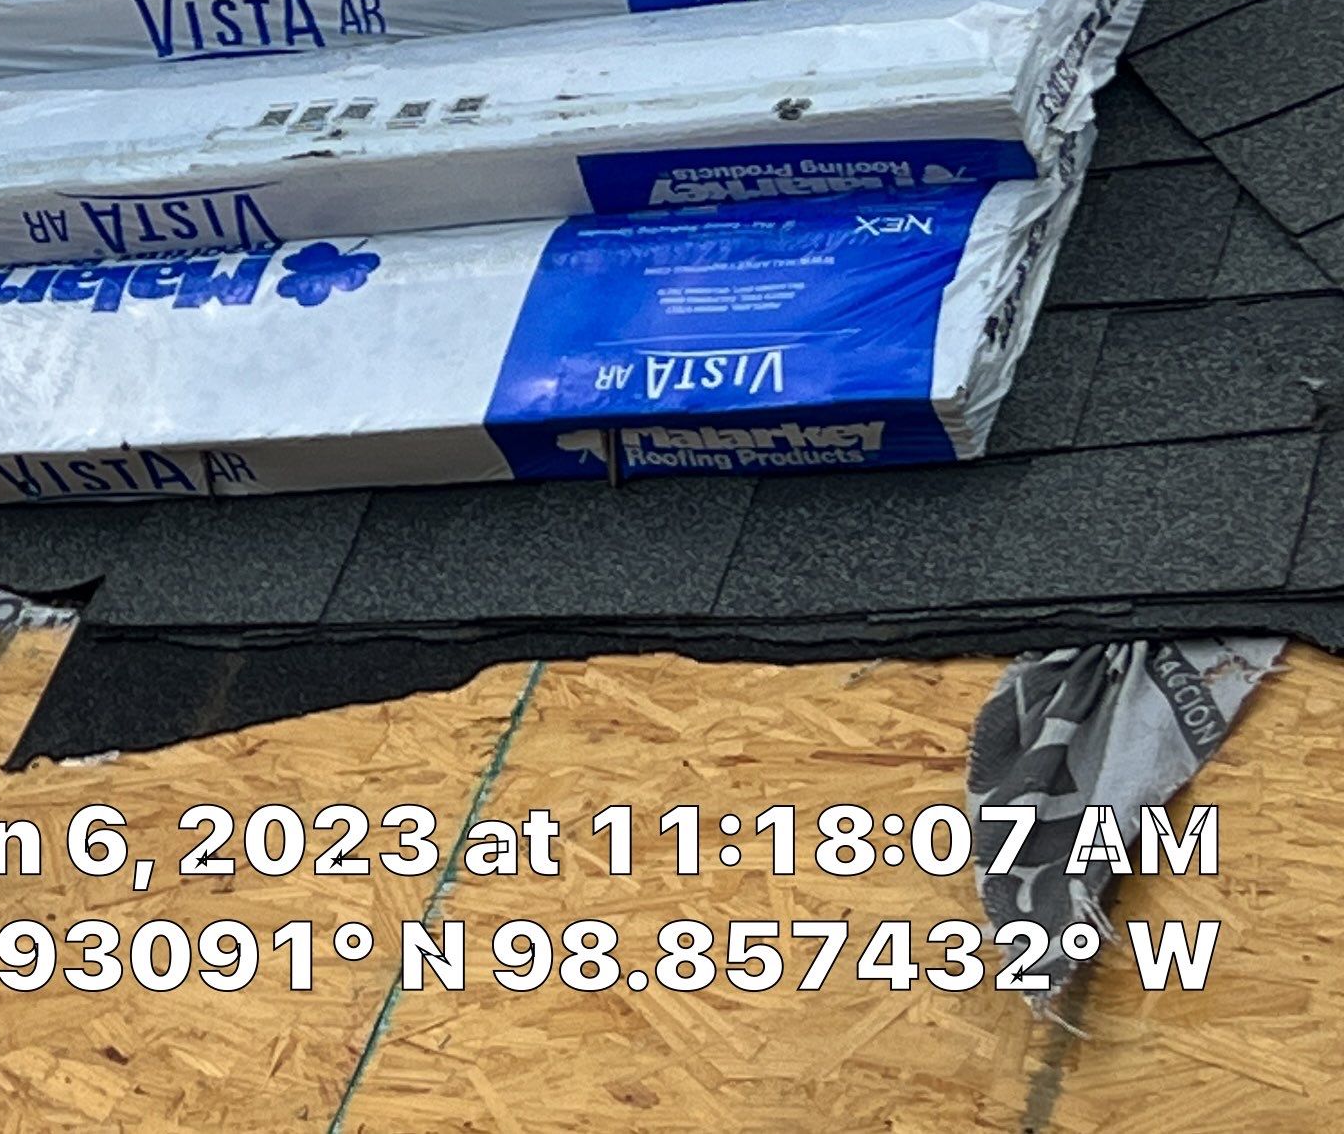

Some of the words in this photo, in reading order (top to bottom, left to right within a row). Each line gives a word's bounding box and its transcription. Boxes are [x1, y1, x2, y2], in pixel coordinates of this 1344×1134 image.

[671, 163, 794, 182] Products
[22, 210, 69, 243] AR
[81, 192, 286, 256] VISTA
[854, 214, 935, 236] NEX
[594, 365, 634, 390] AR
[646, 348, 785, 403] VISTA
[620, 421, 887, 458] Malarkey
[626, 445, 732, 472] Roofing
[737, 443, 865, 468] Products
